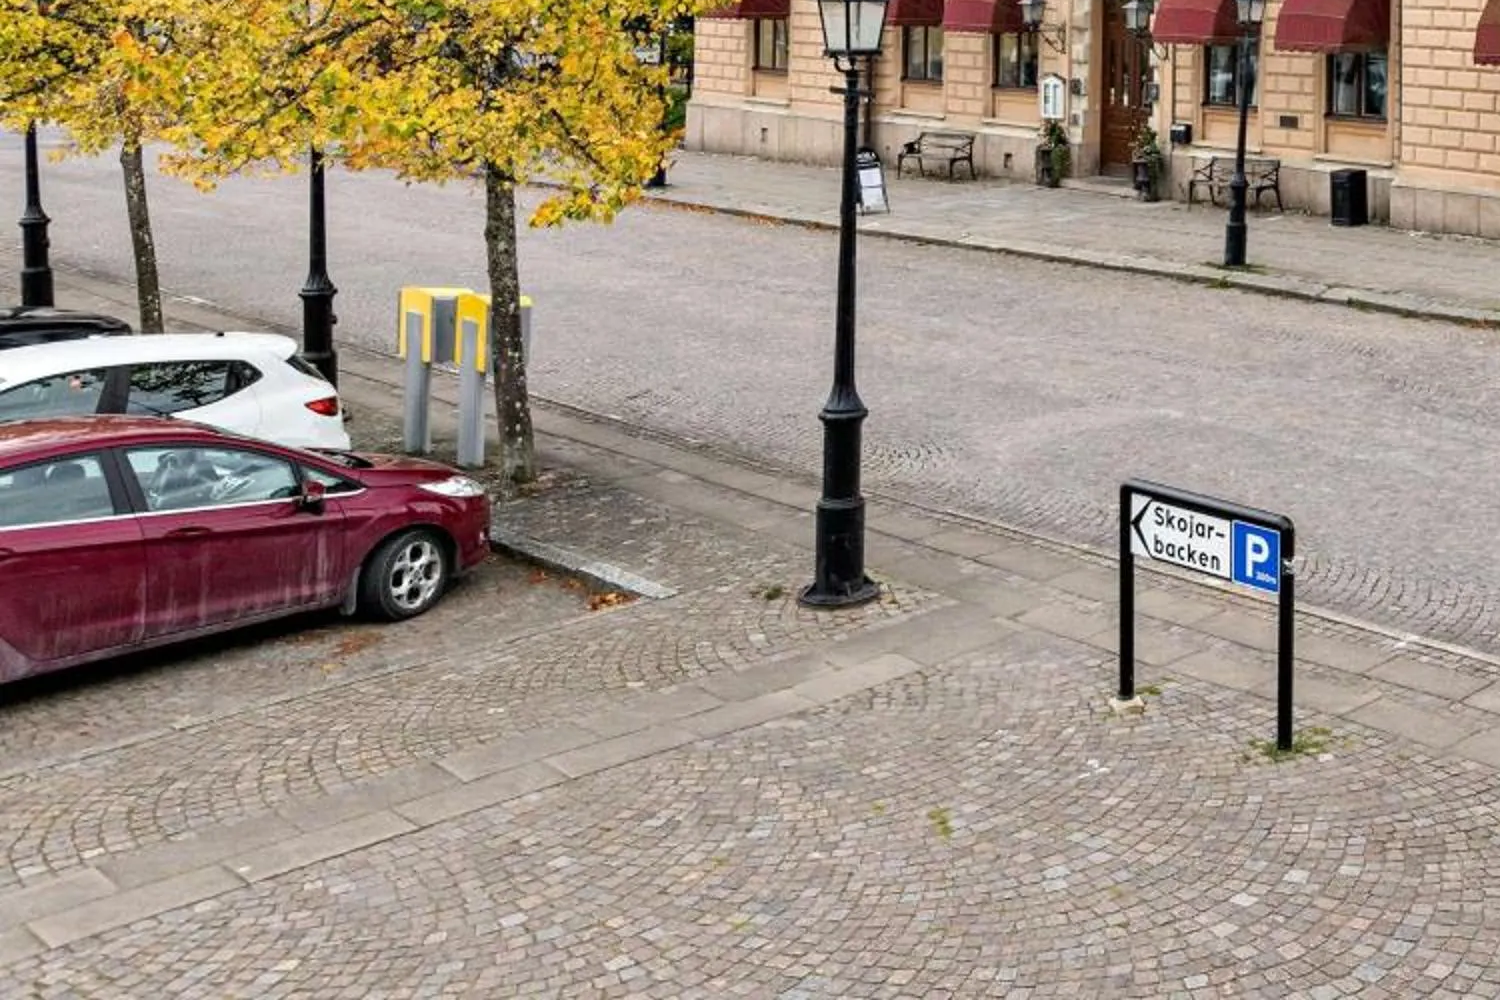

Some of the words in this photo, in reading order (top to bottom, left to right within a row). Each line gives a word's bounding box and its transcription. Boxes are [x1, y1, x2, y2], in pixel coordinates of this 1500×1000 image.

[1154, 506, 1225, 539] Skojar-
[1154, 534, 1220, 570] backen
[1246, 533, 1269, 578] P
